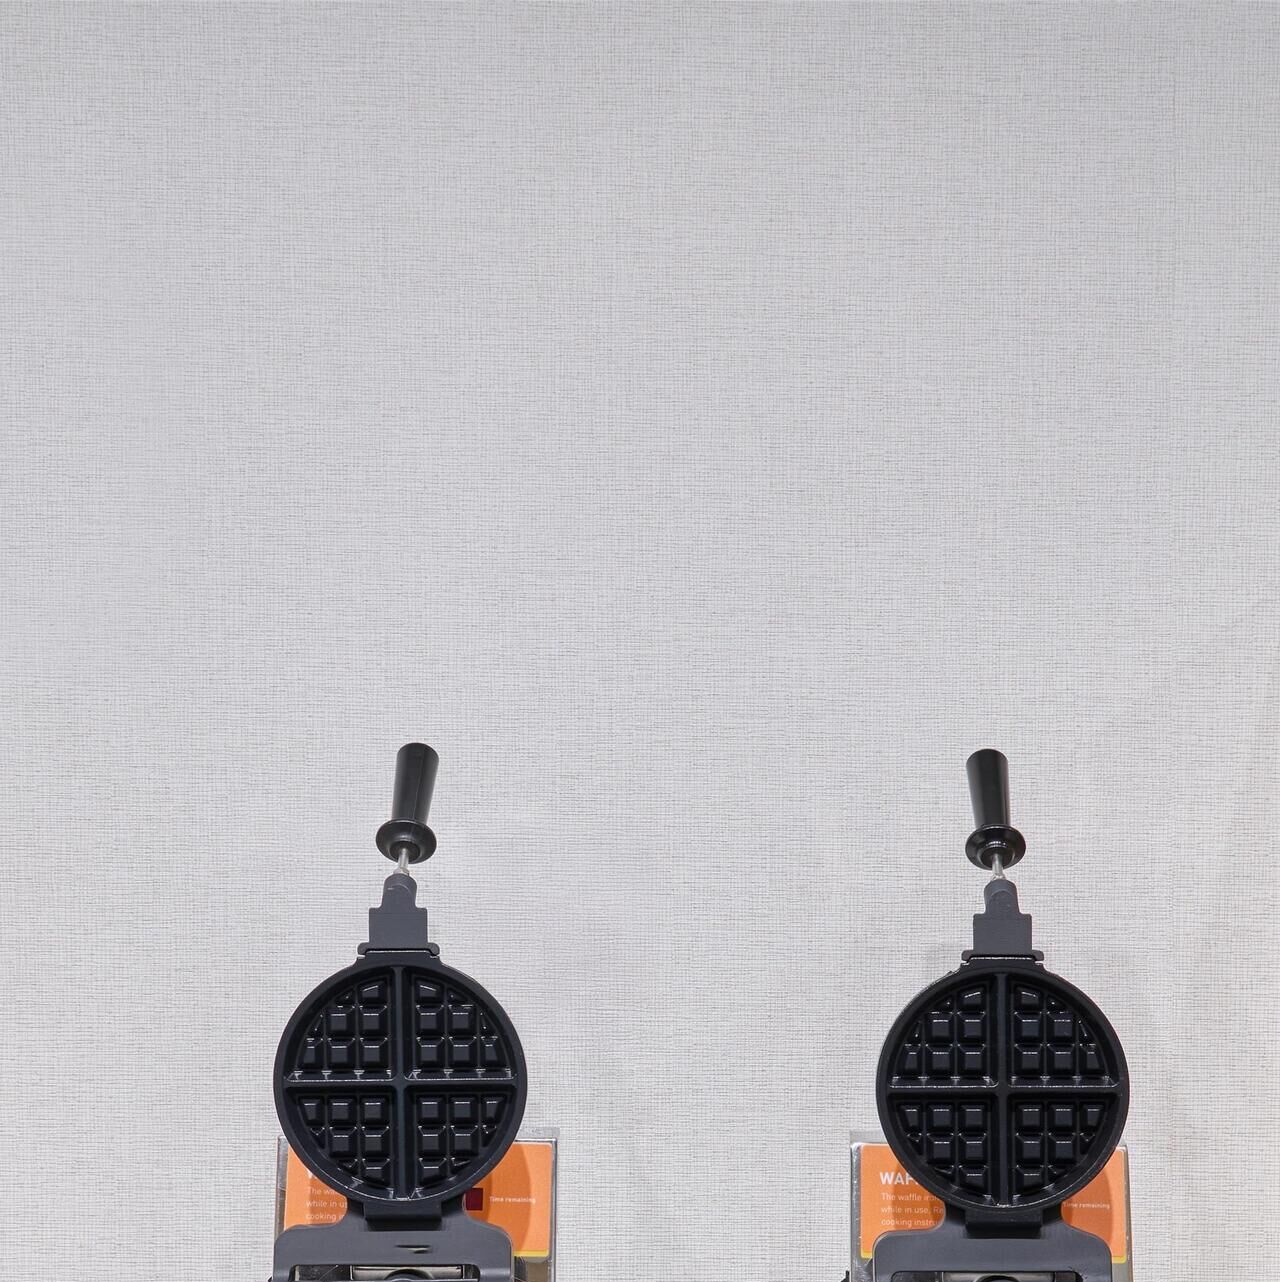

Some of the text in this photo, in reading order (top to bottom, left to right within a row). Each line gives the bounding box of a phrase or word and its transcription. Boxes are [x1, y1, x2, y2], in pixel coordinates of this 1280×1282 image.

[882, 1193, 921, 1201] The waffle
[306, 1200, 327, 1208] while
[881, 1206, 902, 1214] while
[306, 1213, 336, 1221] cooking
[881, 1219, 912, 1227] cooking
